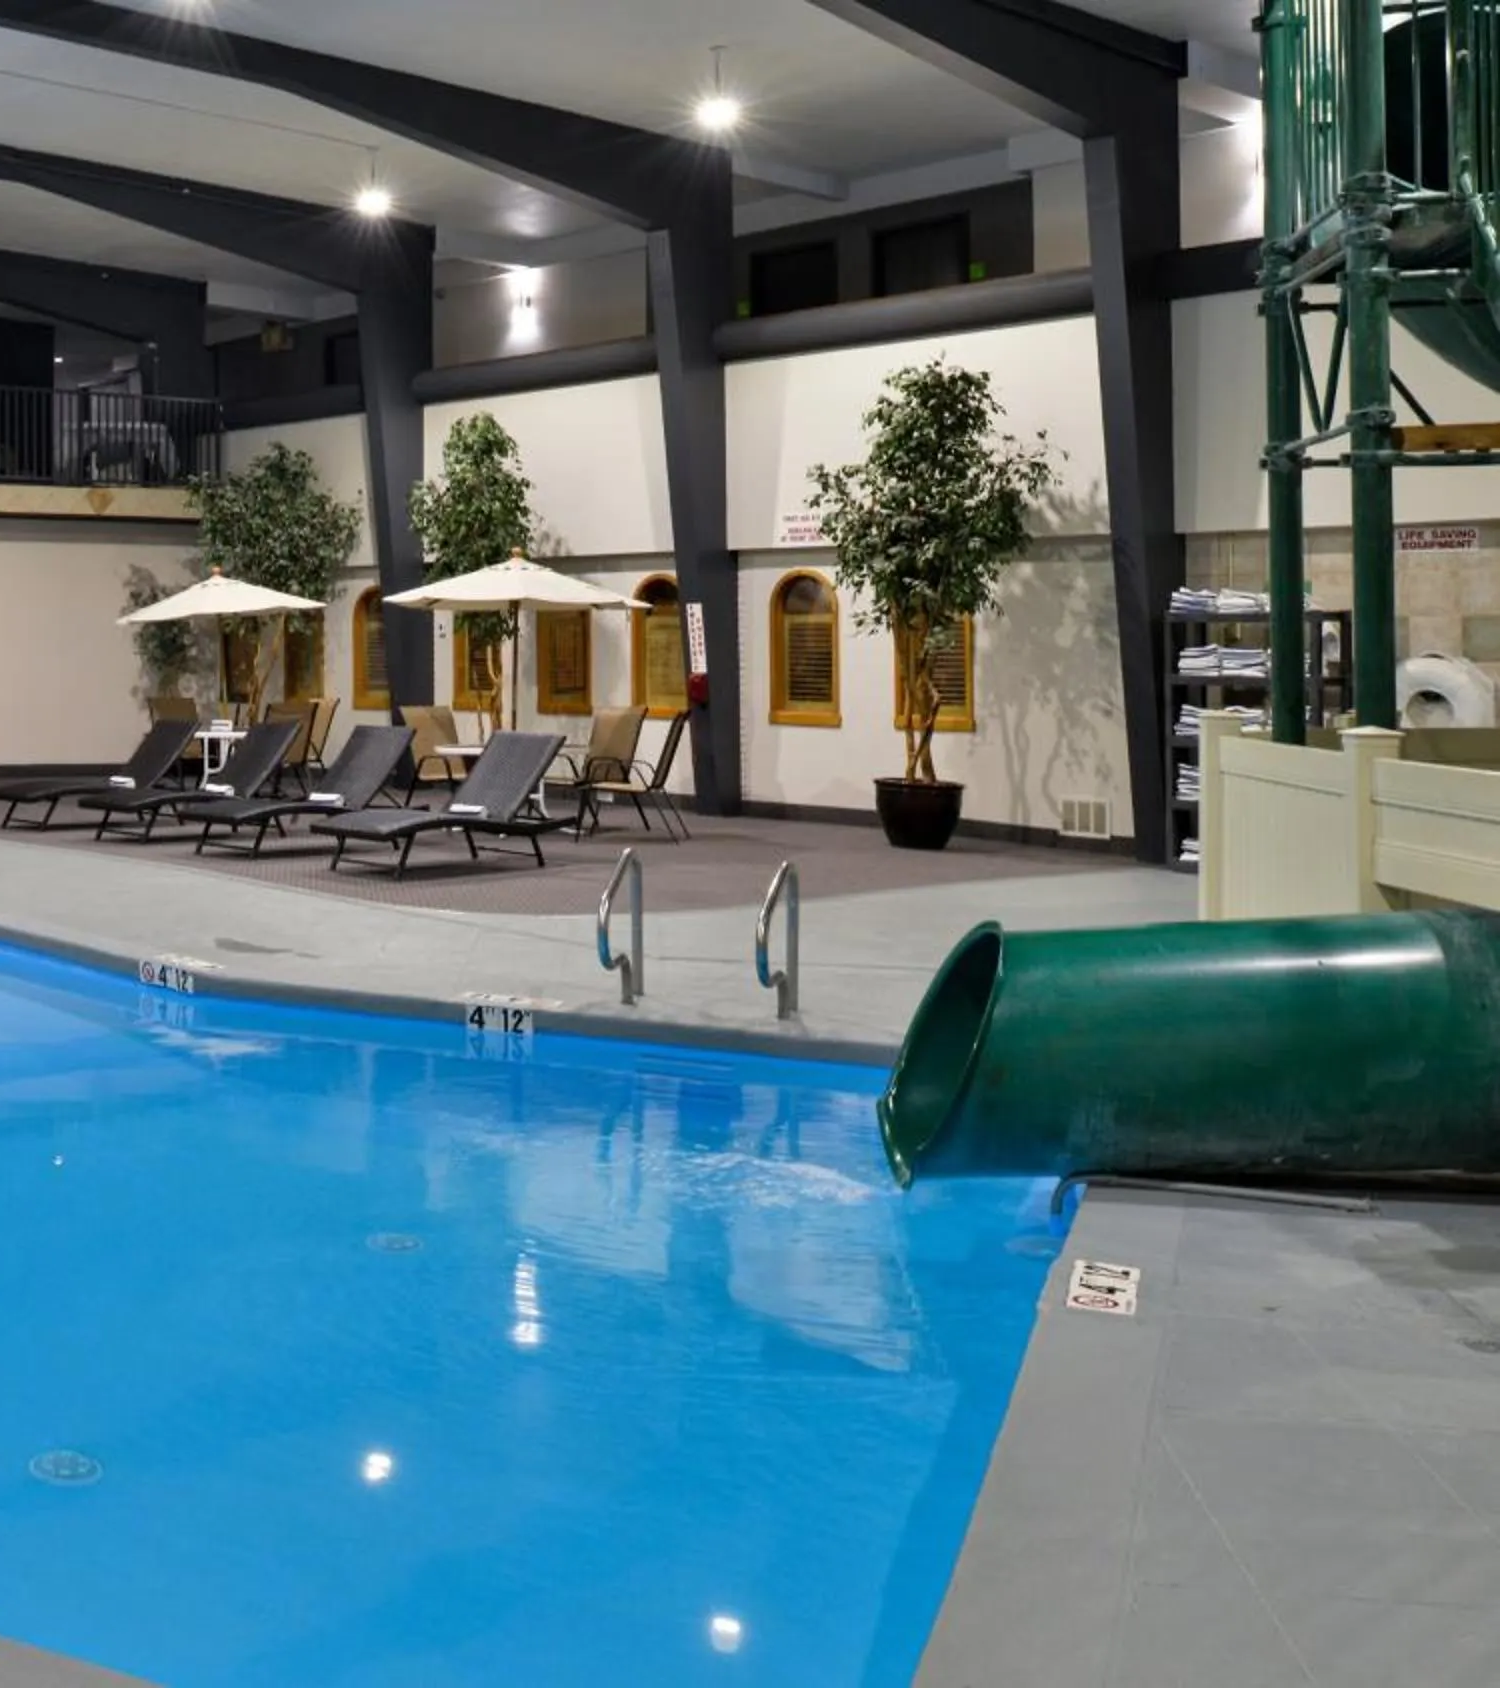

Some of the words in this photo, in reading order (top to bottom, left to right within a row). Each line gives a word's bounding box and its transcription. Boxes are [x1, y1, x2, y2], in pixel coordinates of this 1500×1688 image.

[1399, 529, 1424, 541] LIFE
[1431, 527, 1476, 539] SAVING
[1401, 539, 1472, 550] EQUIPMENT
[469, 1005, 486, 1030] 4
